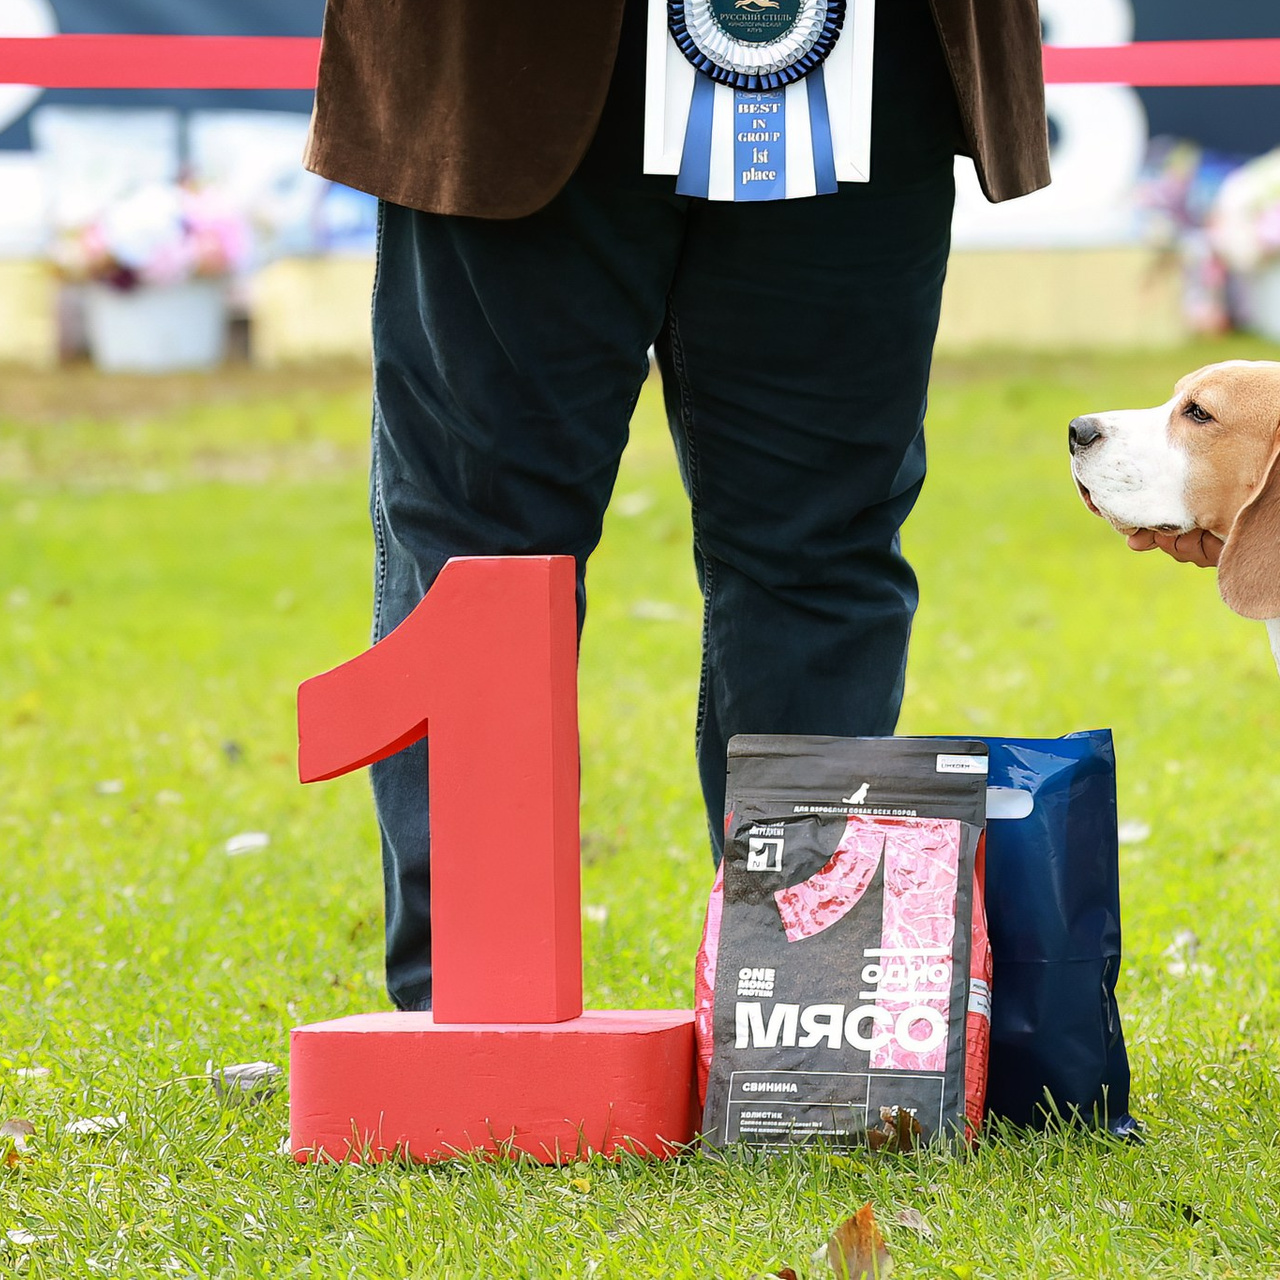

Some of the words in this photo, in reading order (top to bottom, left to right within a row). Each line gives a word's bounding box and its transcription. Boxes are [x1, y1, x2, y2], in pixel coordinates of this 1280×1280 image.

[720, 12, 760, 21] РУССКИЙ
[762, 13, 792, 21] СТИЛЬ
[738, 103, 781, 114] BEST
[752, 119, 767, 129] IN
[737, 131, 780, 142] GROUP
[752, 147, 769, 164] 1st
[742, 167, 776, 185] place
[297, 555, 582, 1024] 1
[793, 805, 809, 813] ДЛЯ
[810, 806, 848, 814] ВЗРОСЛЫХ
[892, 809, 917, 817] ПОРОД
[739, 967, 776, 981] ONE
[738, 980, 774, 990] MONO
[737, 988, 773, 997] PROTEIN
[734, 1001, 949, 1053] МЯСО
[742, 1082, 798, 1093] СВИНИНА
[740, 1111, 783, 1119] ХОЛИСТИК
